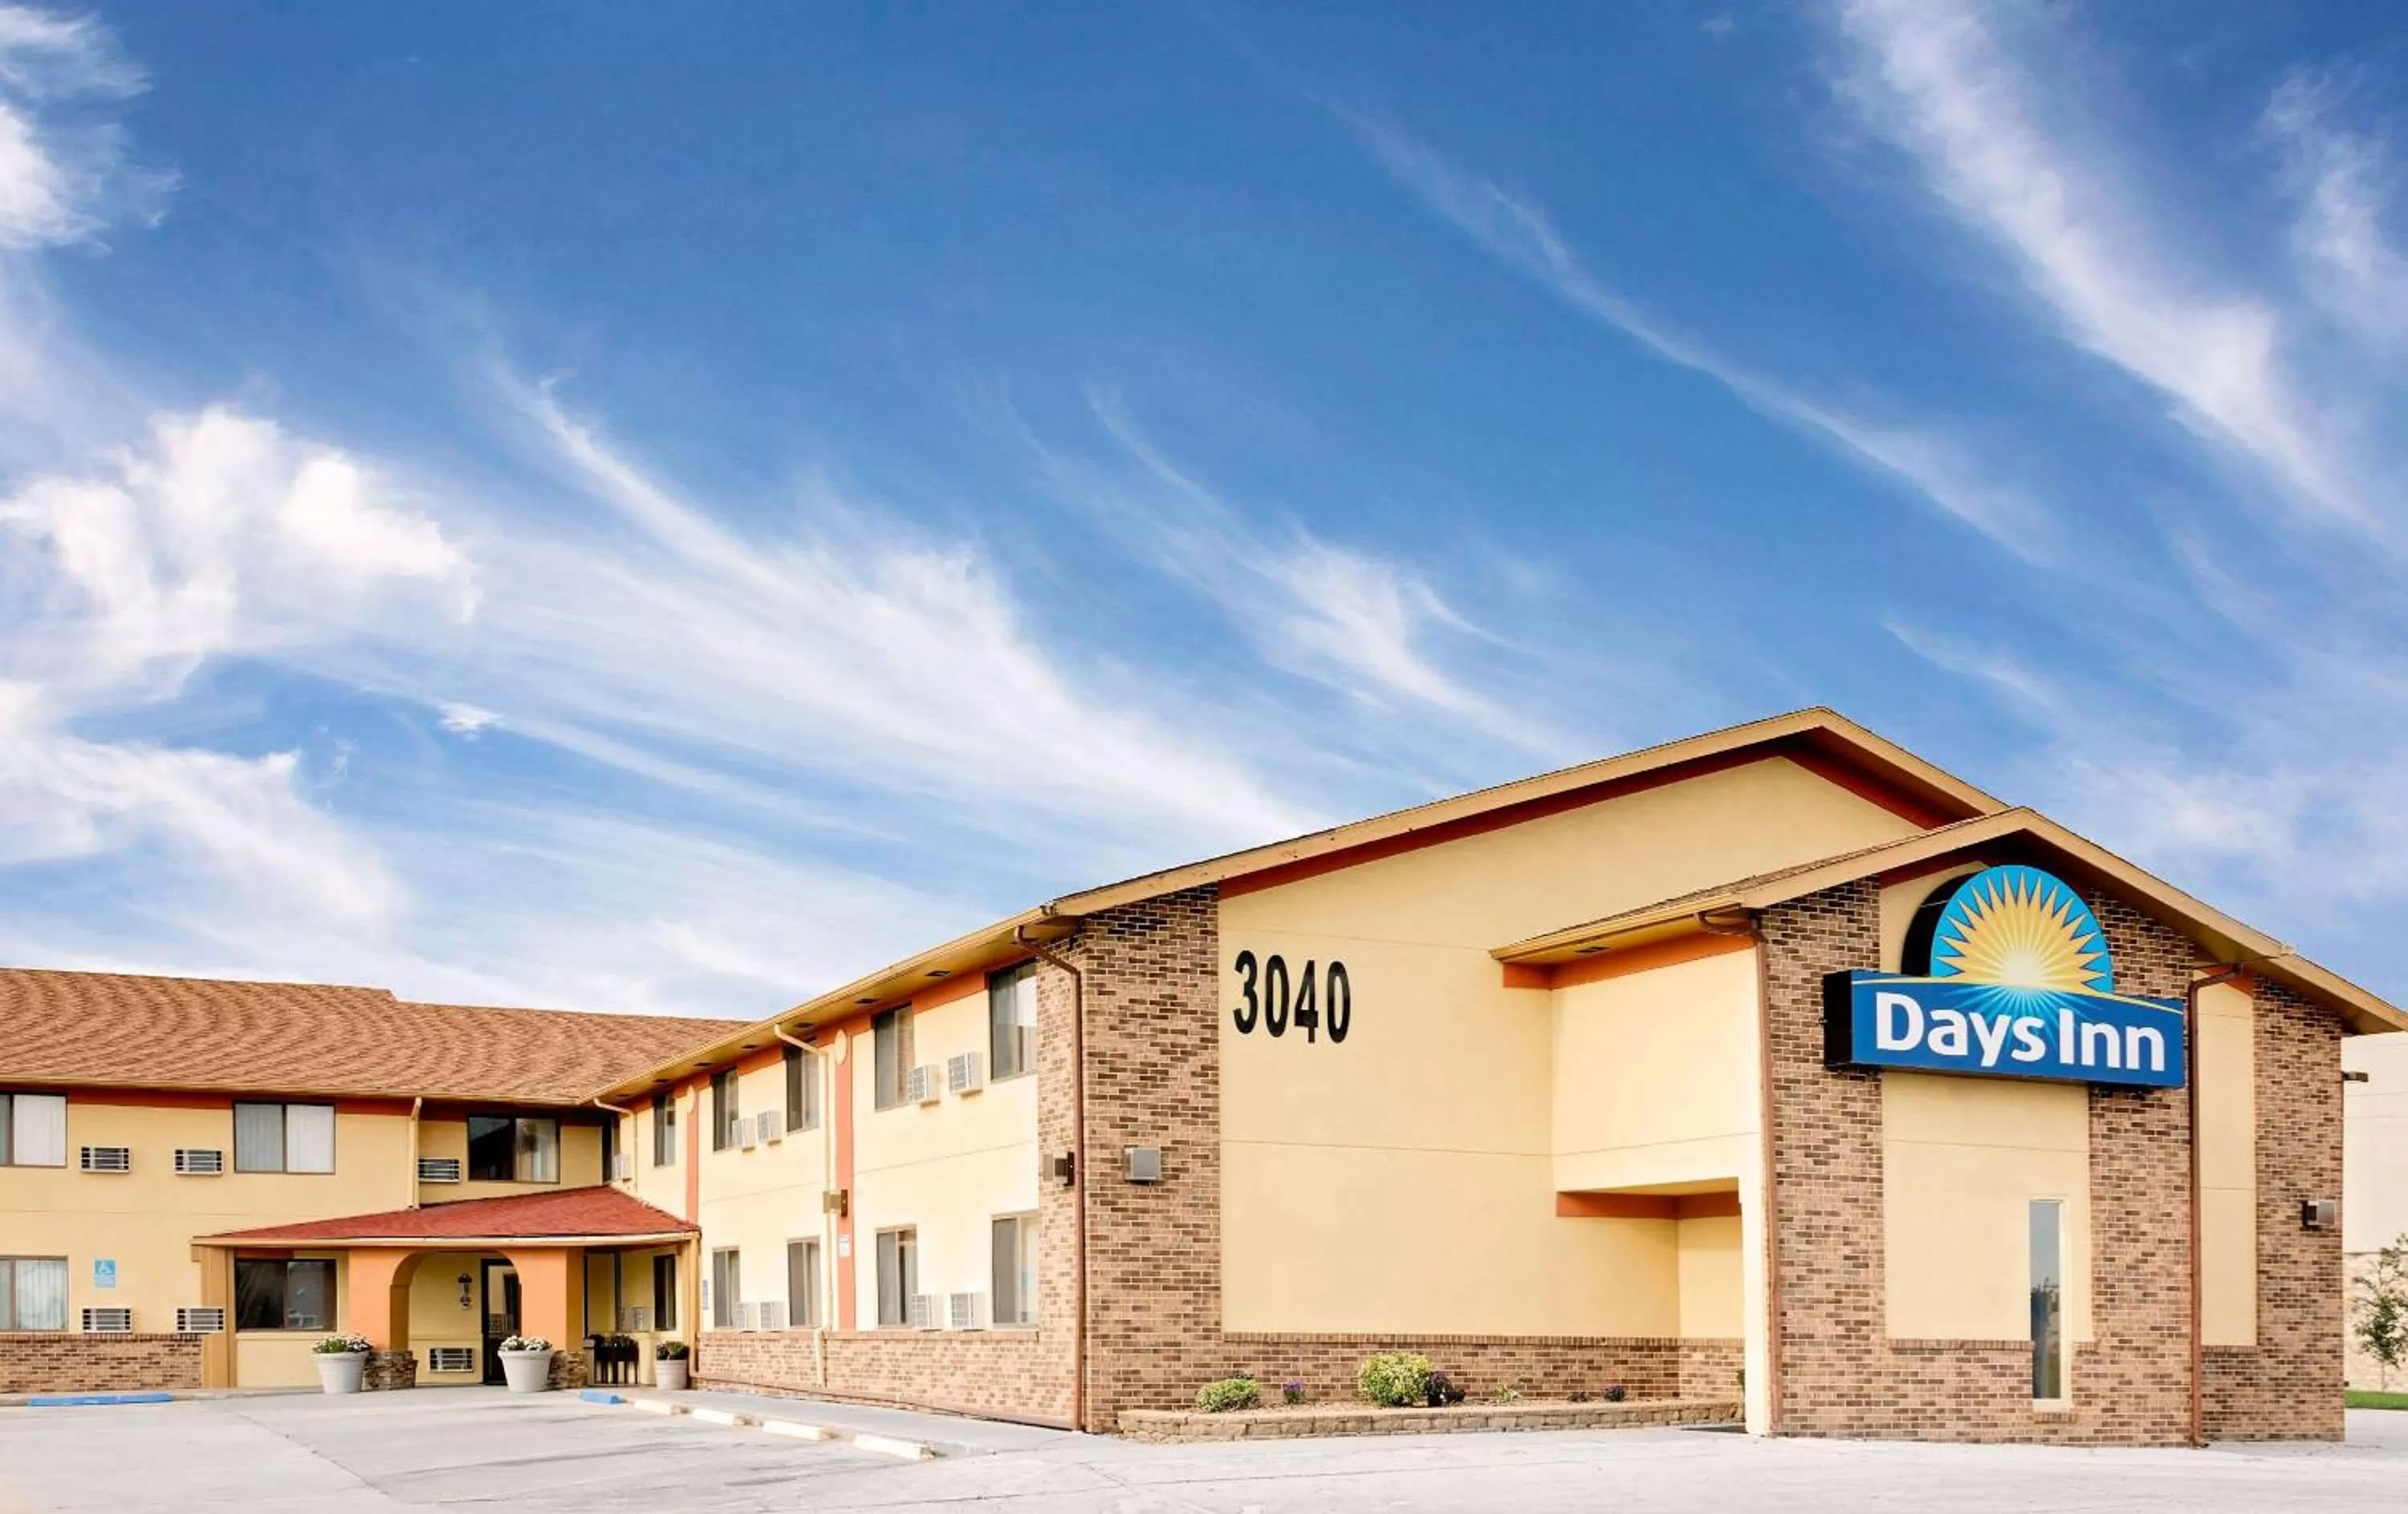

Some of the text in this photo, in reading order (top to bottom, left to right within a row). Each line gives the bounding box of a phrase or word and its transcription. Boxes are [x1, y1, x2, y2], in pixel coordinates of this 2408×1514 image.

[1233, 950, 1351, 1044] 3040
[1875, 991, 2165, 1072] Days Inn
